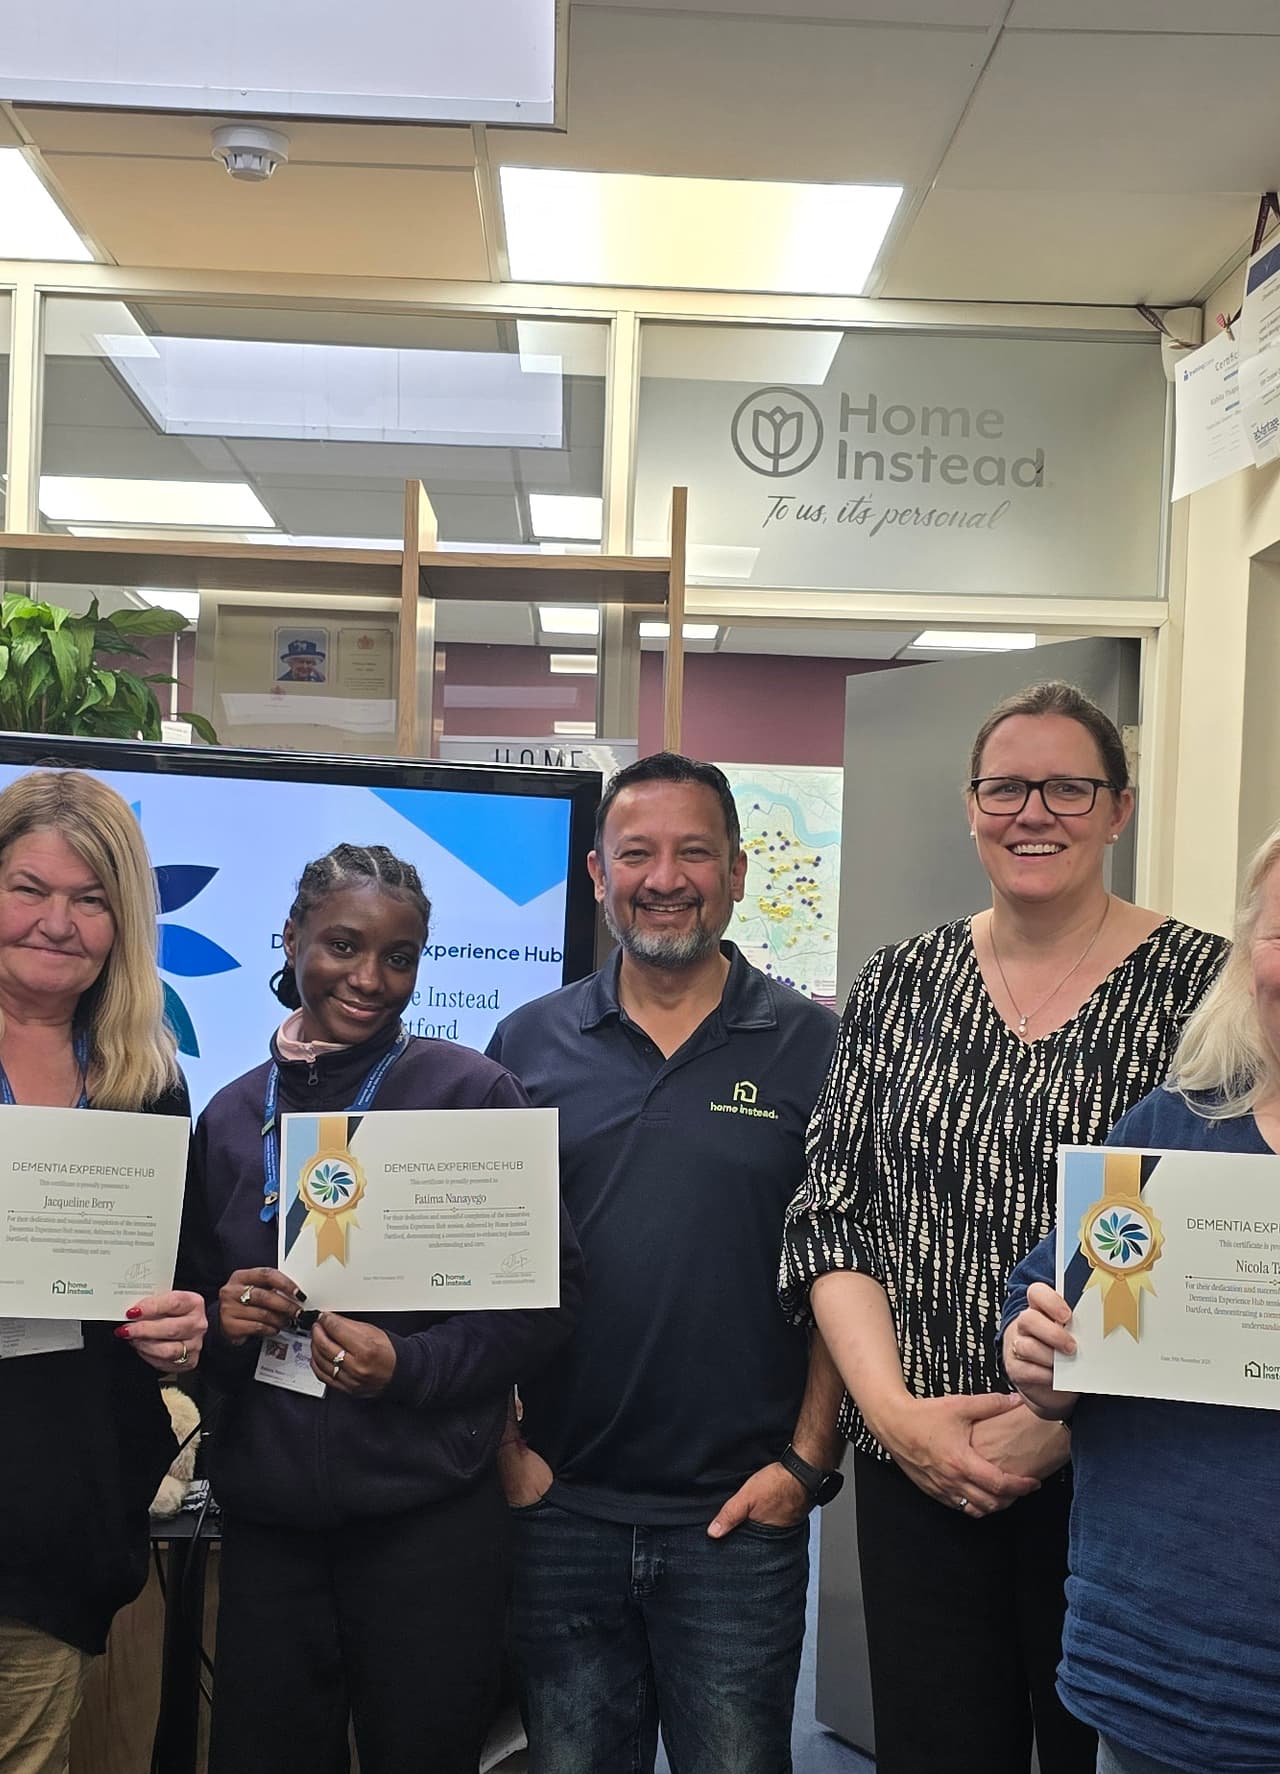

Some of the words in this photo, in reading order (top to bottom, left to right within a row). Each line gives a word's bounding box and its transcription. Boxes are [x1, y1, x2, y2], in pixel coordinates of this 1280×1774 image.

[839, 392, 1005, 439] Home
[837, 439, 1046, 488] Instead
[762, 495, 796, 528] To
[796, 503, 828, 525] us,
[836, 493, 876, 525] it's
[869, 500, 1011, 537] personal
[423, 943, 520, 964] xperience
[524, 945, 563, 963] Hub
[428, 986, 500, 1010] Instead
[405, 1020, 458, 1041] tford
[710, 1101, 738, 1113] home
[12, 1162, 68, 1173] DEMENTIA
[70, 1164, 132, 1177] EXPERIENCE
[135, 1167, 155, 1178] HUB
[384, 1163, 435, 1173] DEMENTIA
[437, 1161, 500, 1171] EXPERIENCE
[502, 1160, 524, 1170] HUB
[43, 1195, 90, 1210] Jacqueline
[92, 1197, 116, 1211] Berry
[414, 1193, 444, 1205] Fatima
[1187, 1218, 1252, 1233] DEMENTIA
[1219, 1239, 1232, 1248] This
[1233, 1241, 1262, 1250] certificate
[1264, 1242, 1269, 1250] is
[1236, 1260, 1270, 1274] Nicola
[67, 1280, 88, 1288] home
[1185, 1282, 1195, 1290] For
[1196, 1283, 1210, 1291] their
[1243, 1286, 1256, 1294] and
[1189, 1294, 1218, 1303] Dementia
[1218, 1296, 1251, 1306] Experience
[1251, 1298, 1265, 1306] Hub
[1185, 1305, 1213, 1315] Dartford,
[1214, 1307, 1258, 1319] demonstrating
